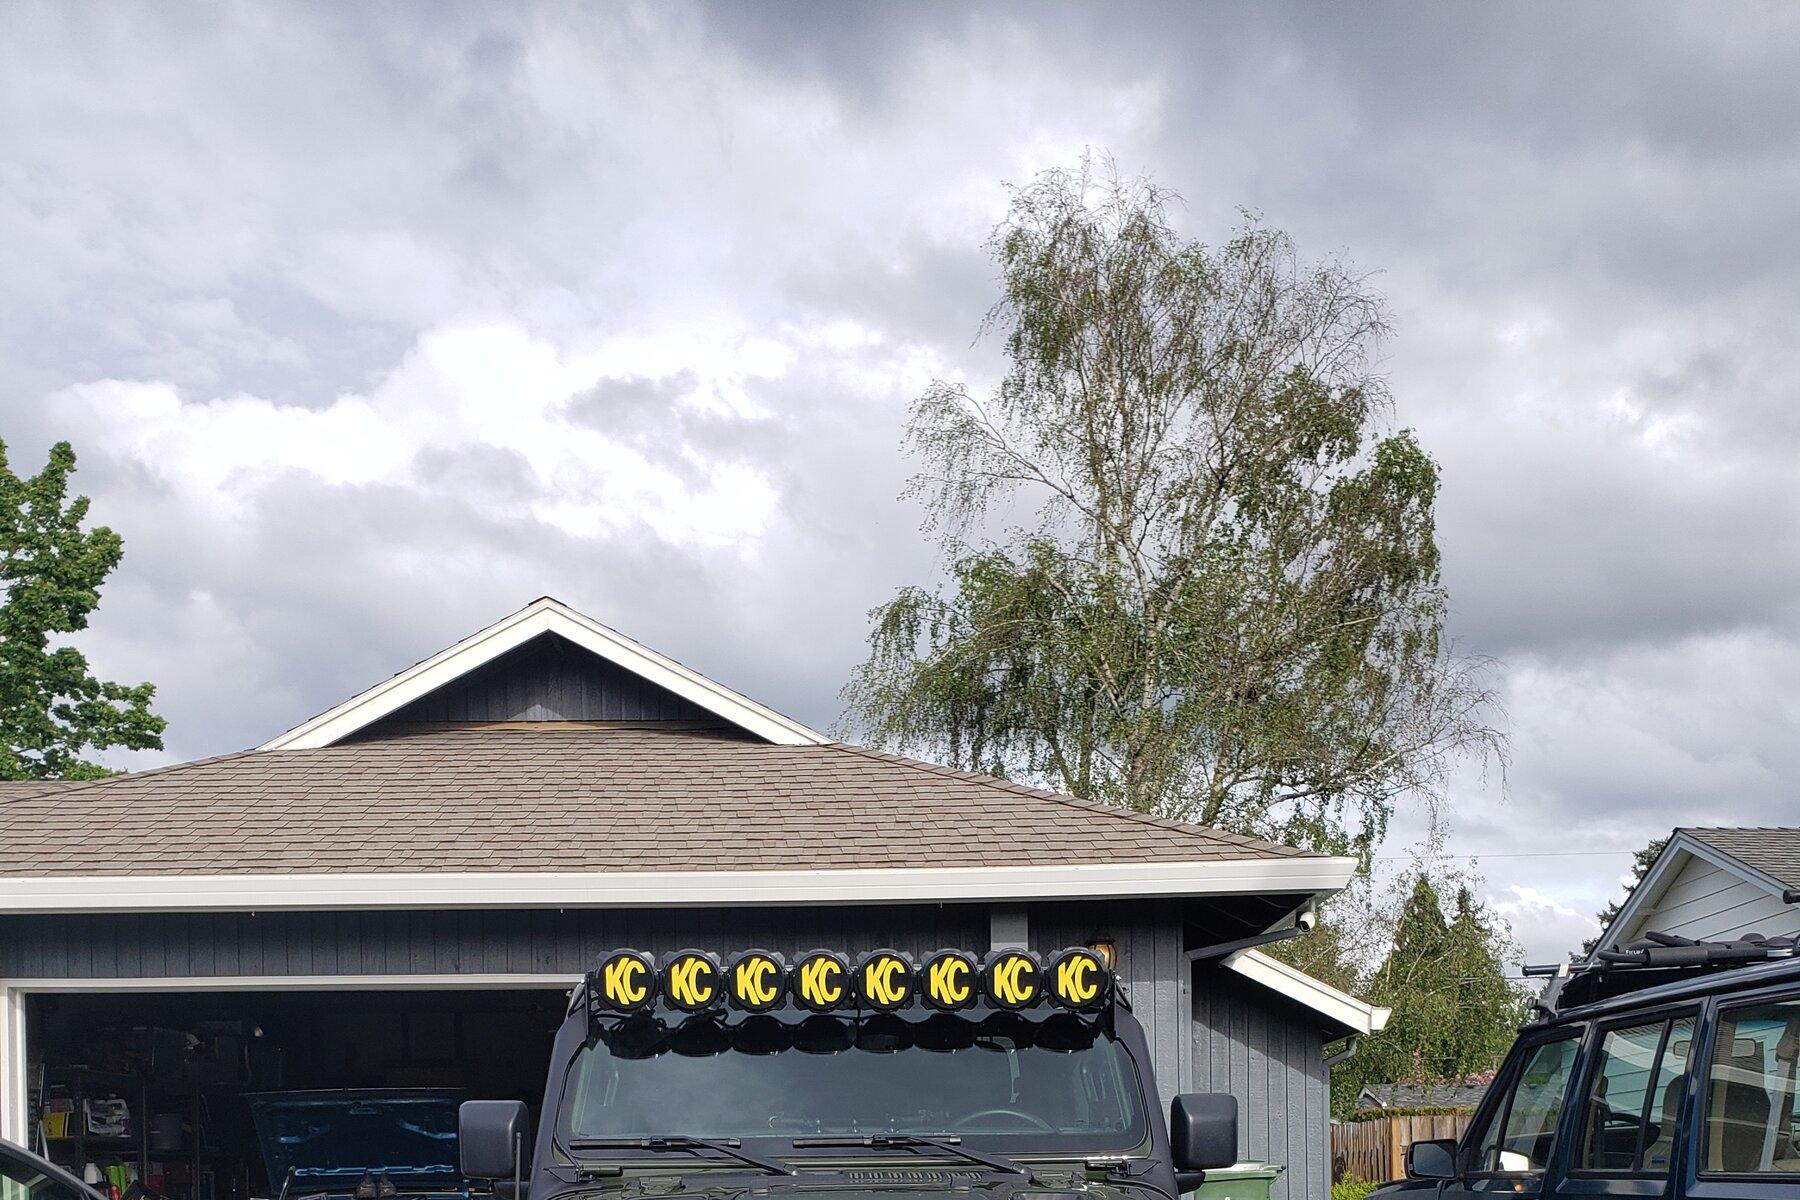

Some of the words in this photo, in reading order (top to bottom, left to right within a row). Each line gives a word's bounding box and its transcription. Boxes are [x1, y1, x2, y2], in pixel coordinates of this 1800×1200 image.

[605, 957, 647, 1005] KC
[671, 957, 712, 1005] KC
[736, 957, 778, 1005] KC
[801, 957, 842, 1005] KC
[866, 957, 906, 1005] KC
[930, 957, 970, 1004] KC
[994, 956, 1034, 1004] KC
[1057, 955, 1098, 1003] KC
